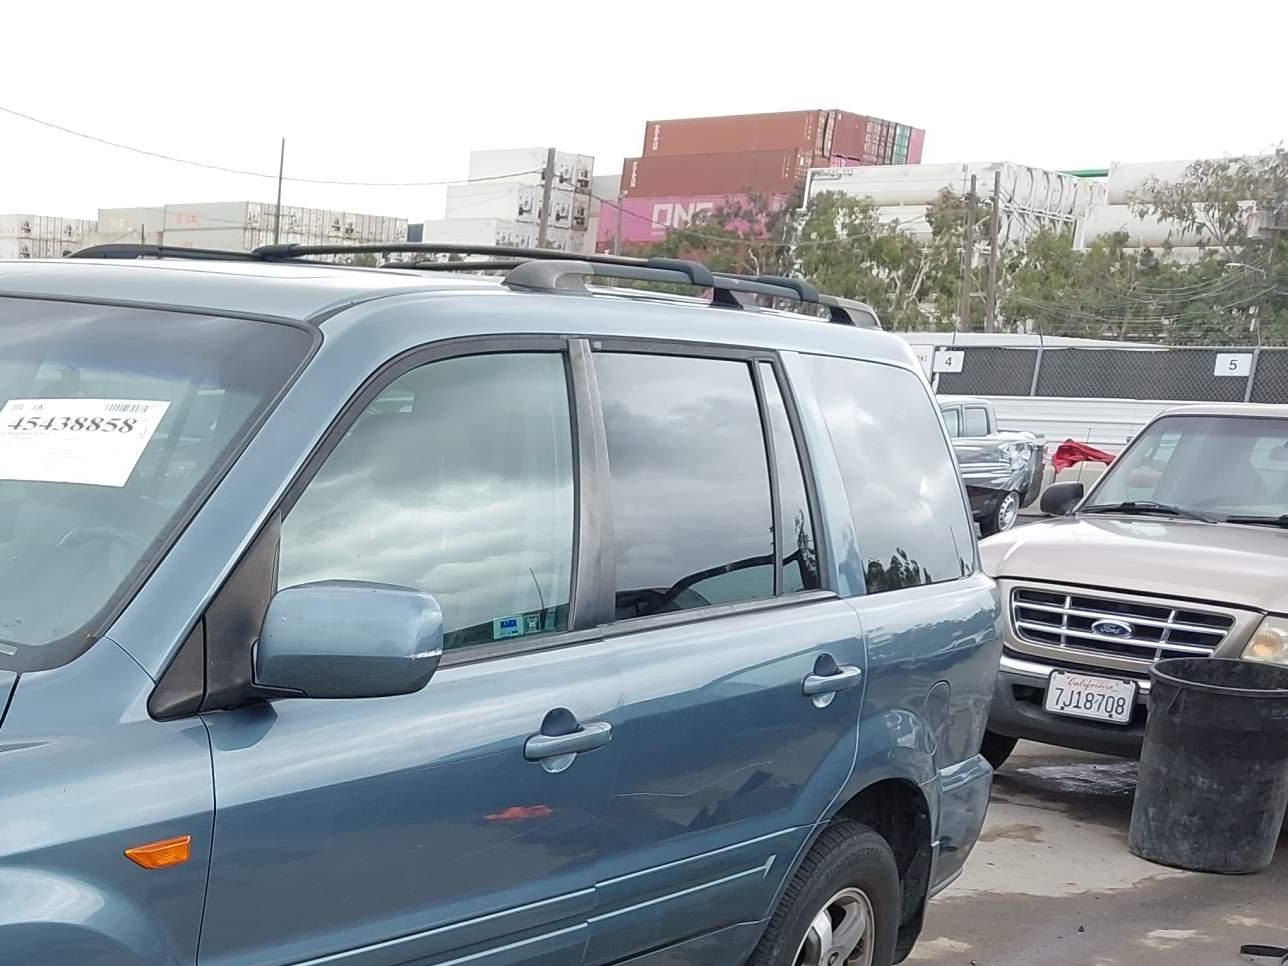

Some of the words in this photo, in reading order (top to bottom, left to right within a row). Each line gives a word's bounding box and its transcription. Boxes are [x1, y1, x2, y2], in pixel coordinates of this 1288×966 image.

[944, 356, 952, 367] 4
[1228, 359, 1239, 371] 5
[8, 416, 138, 434] 45438858
[1100, 623, 1123, 634] Ford
[1067, 677, 1114, 690] California
[1055, 687, 1127, 715] 7J18708
